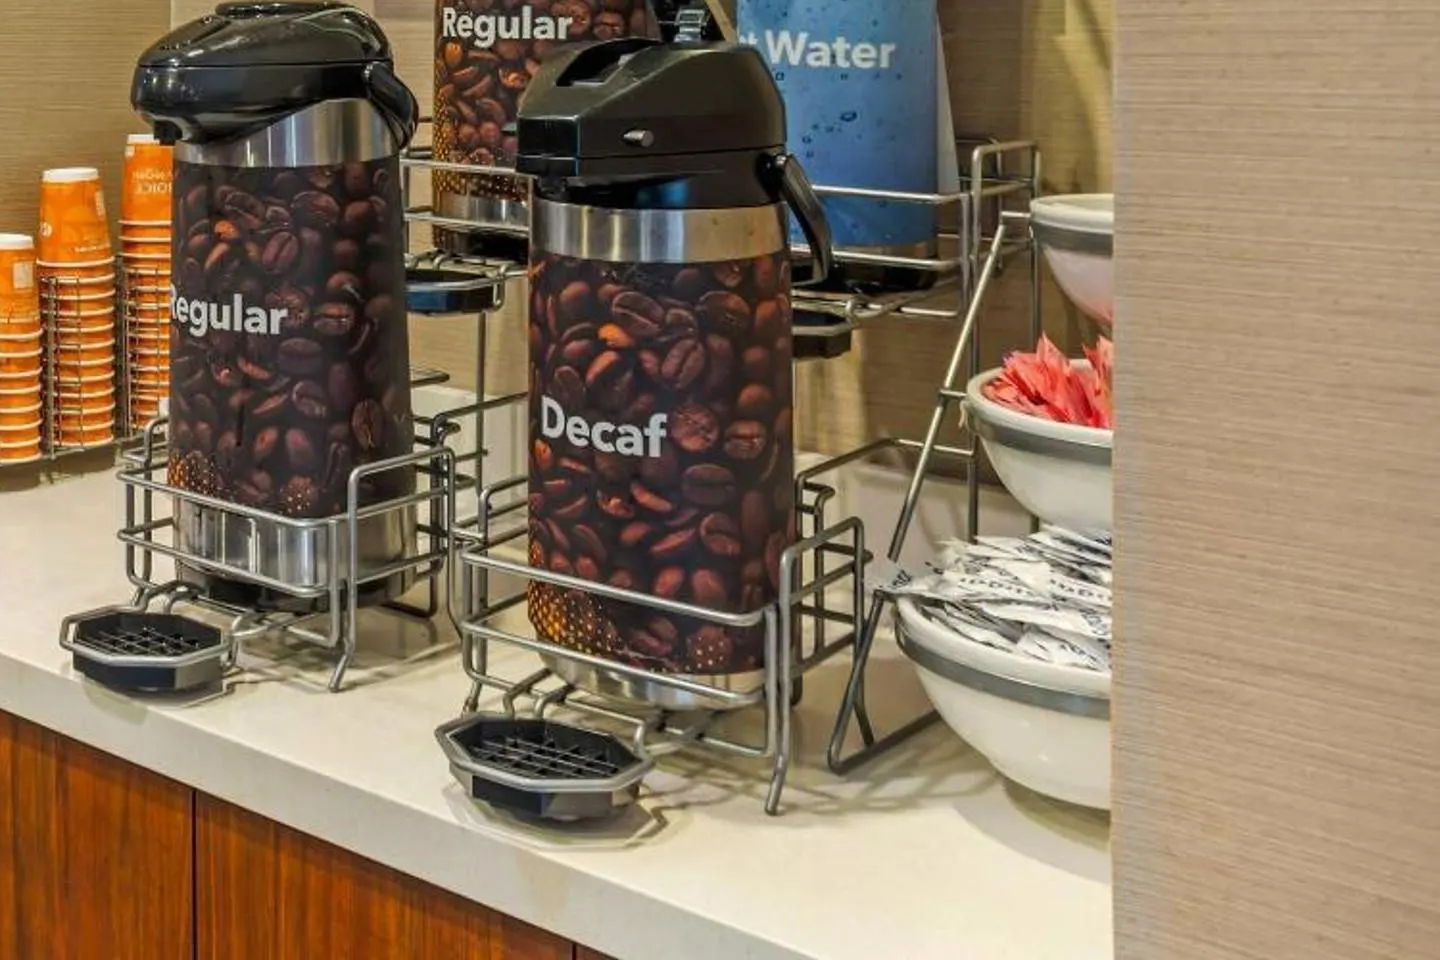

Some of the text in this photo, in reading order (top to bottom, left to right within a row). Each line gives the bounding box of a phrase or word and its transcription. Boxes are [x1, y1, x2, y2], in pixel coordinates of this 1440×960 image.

[442, 5, 573, 48] Regular
[764, 29, 896, 69] Water
[541, 395, 668, 458] Decaf
